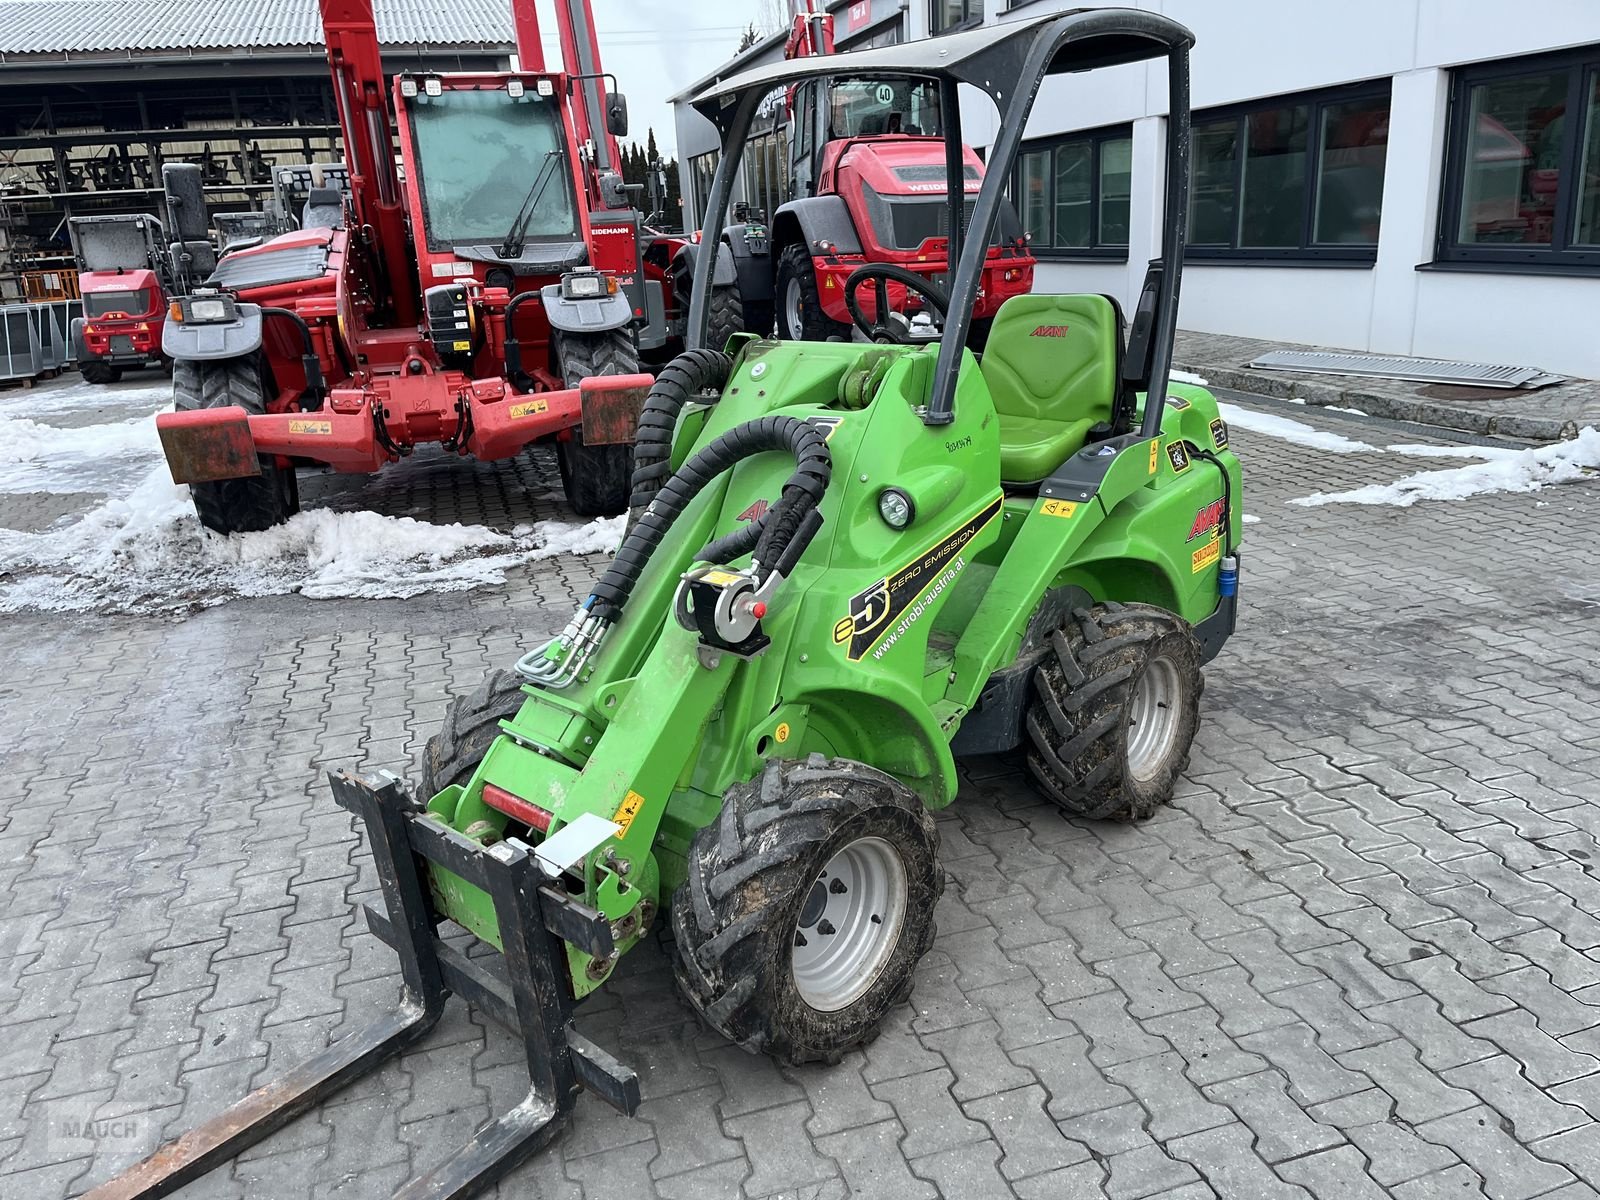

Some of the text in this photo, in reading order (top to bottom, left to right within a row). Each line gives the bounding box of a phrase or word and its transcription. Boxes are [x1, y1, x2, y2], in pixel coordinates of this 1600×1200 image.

[879, 87, 891, 102] 40
[591, 227, 629, 236] EIDEMANN
[1029, 325, 1069, 338] AVANT
[890, 567, 922, 593] ZERO
[924, 526, 976, 569] EMISSION
[872, 556, 966, 660] www.strobl-austria.at
